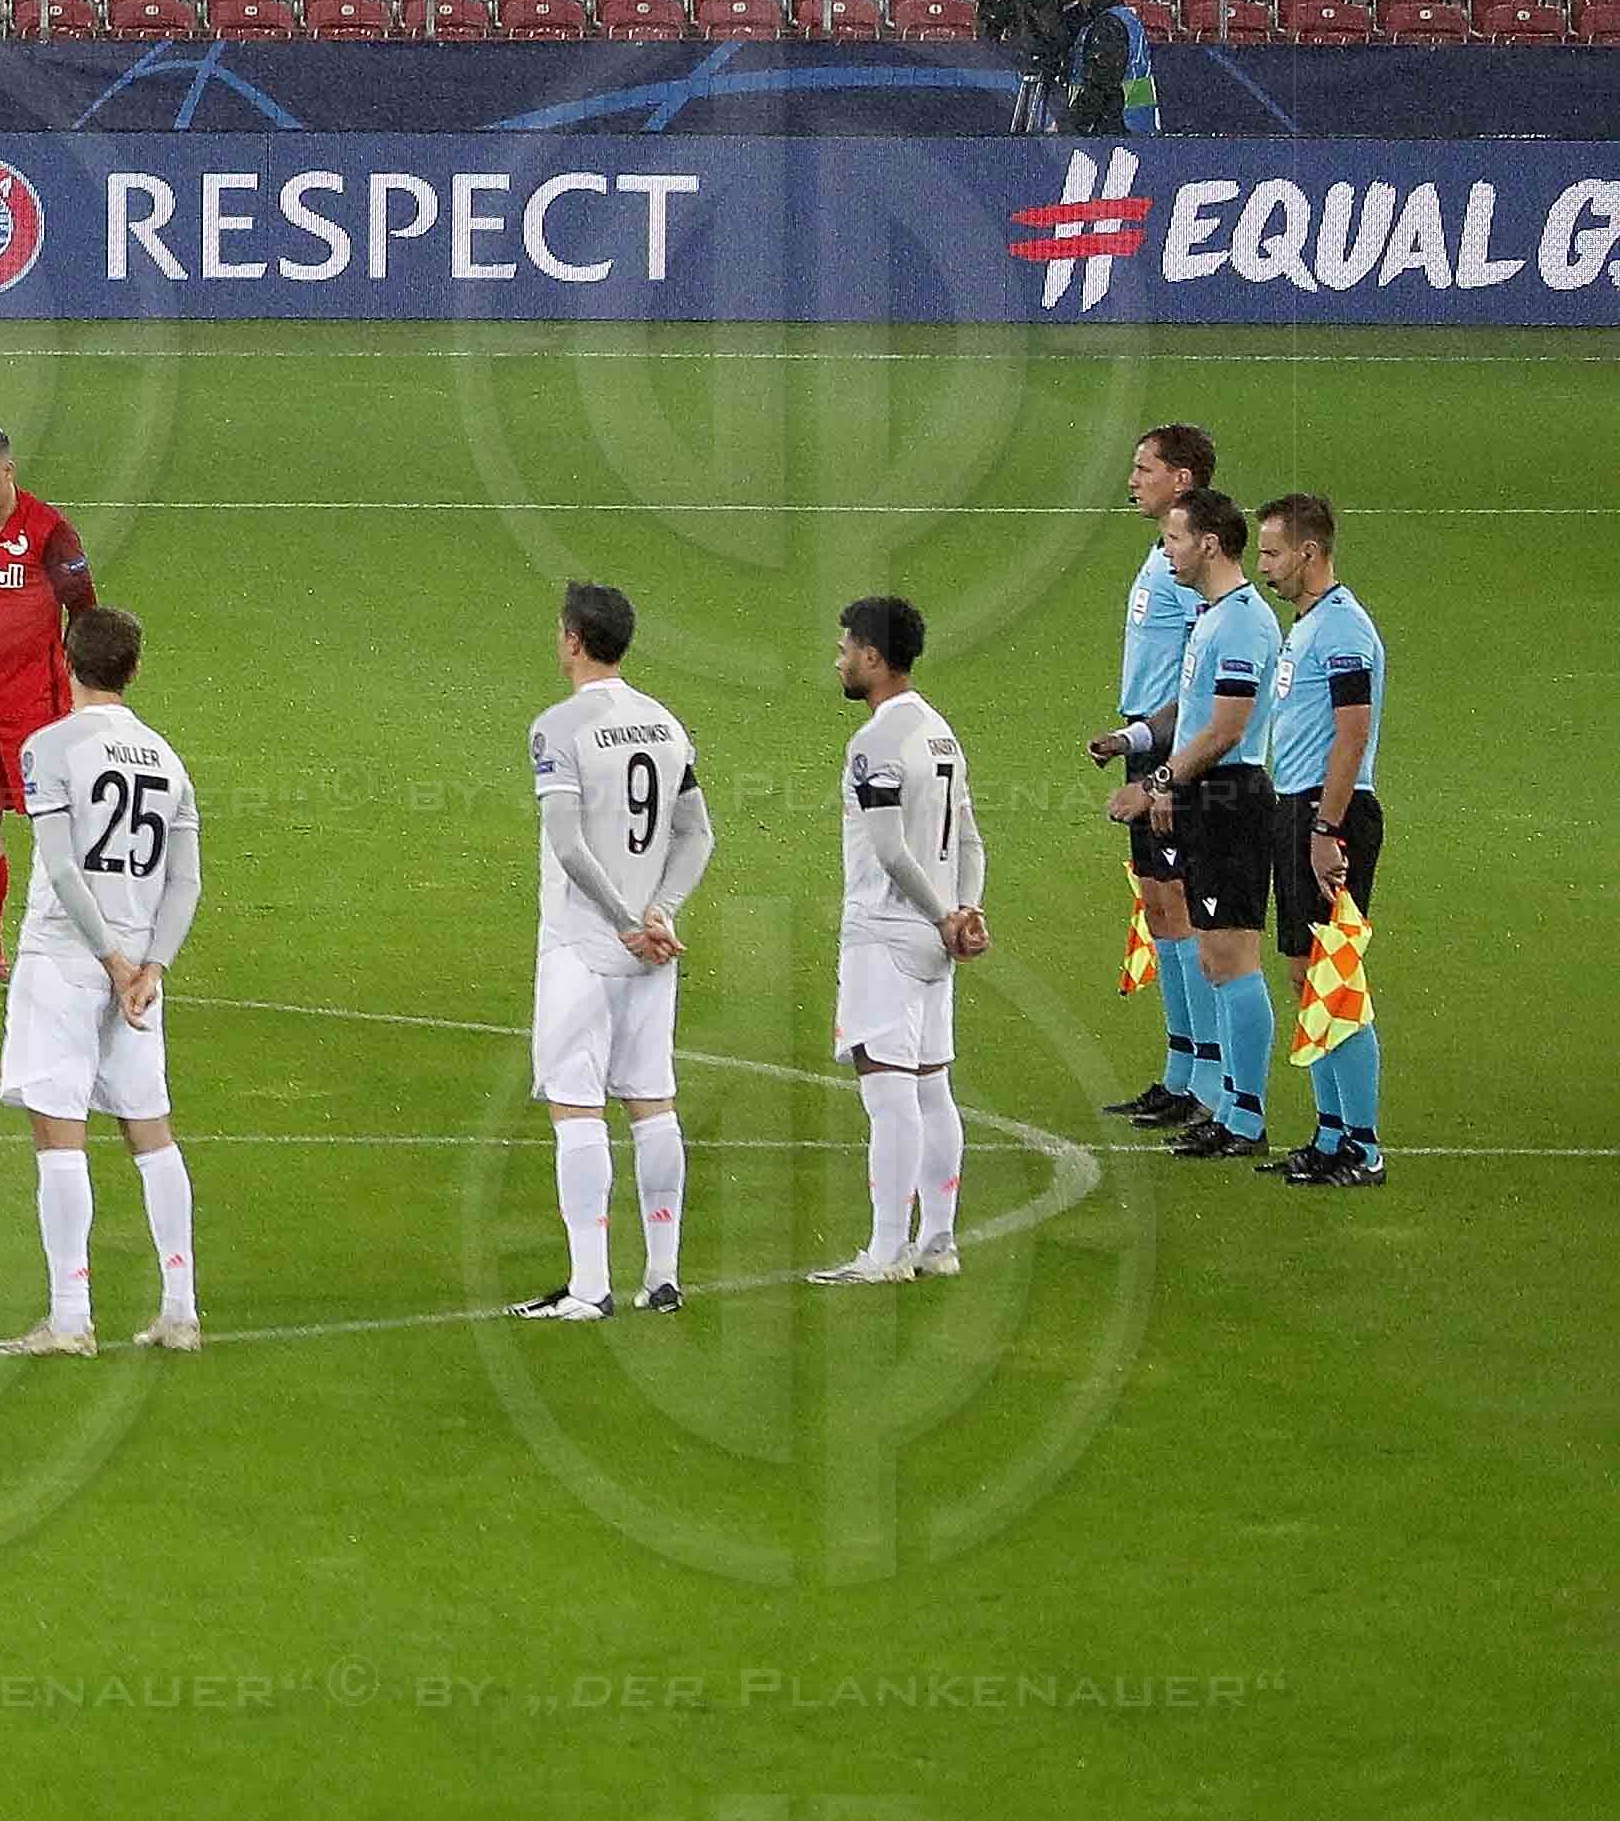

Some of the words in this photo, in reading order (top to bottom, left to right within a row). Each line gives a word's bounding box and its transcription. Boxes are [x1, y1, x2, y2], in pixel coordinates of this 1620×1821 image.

[106, 170, 700, 286] RESPECT
[104, 738, 162, 769] MÜLLER
[626, 750, 660, 855] 9
[83, 770, 171, 878] 25
[935, 762, 956, 861] 7
